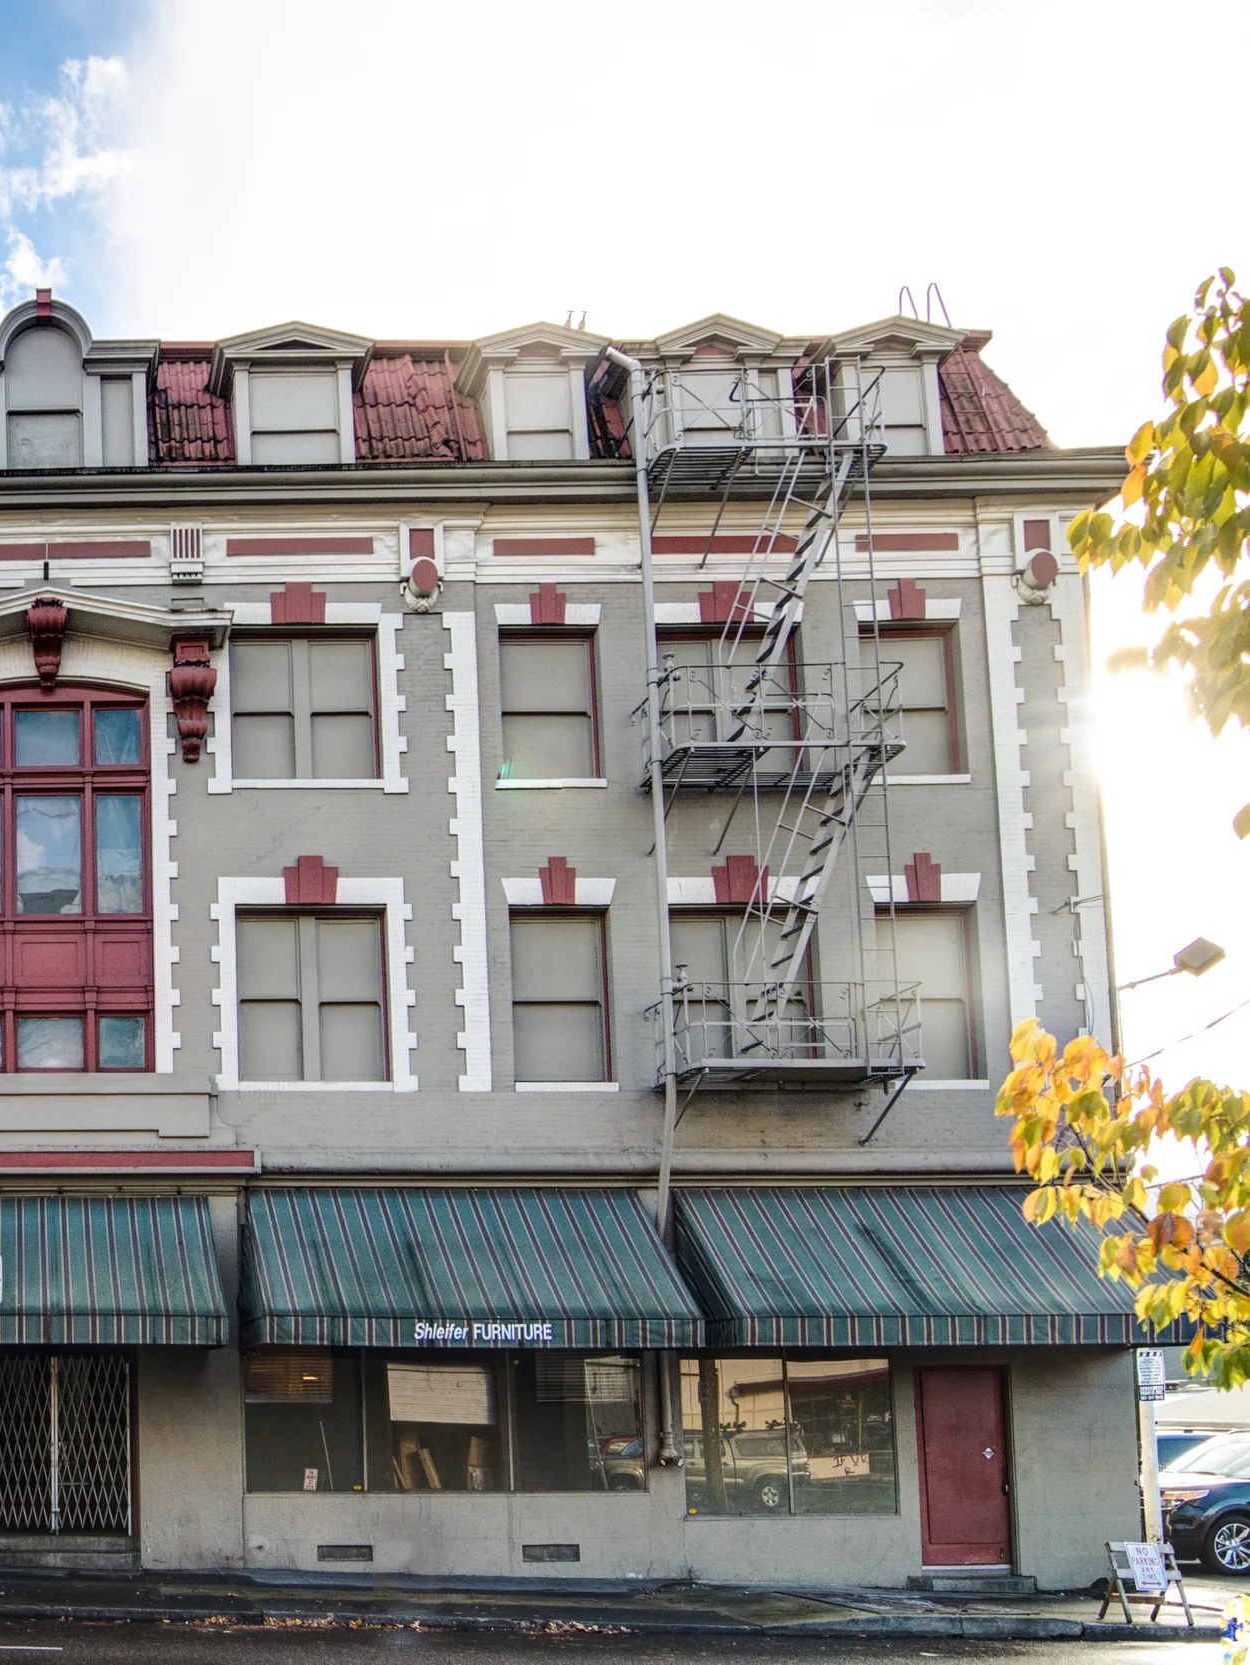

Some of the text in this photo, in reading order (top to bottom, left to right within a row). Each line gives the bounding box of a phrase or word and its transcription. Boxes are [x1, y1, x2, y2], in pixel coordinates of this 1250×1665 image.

[414, 1322, 552, 1341] Shleifer FURNITURE
[1136, 1547, 1149, 1556] NO
[1131, 1557, 1160, 1567] PARKING
